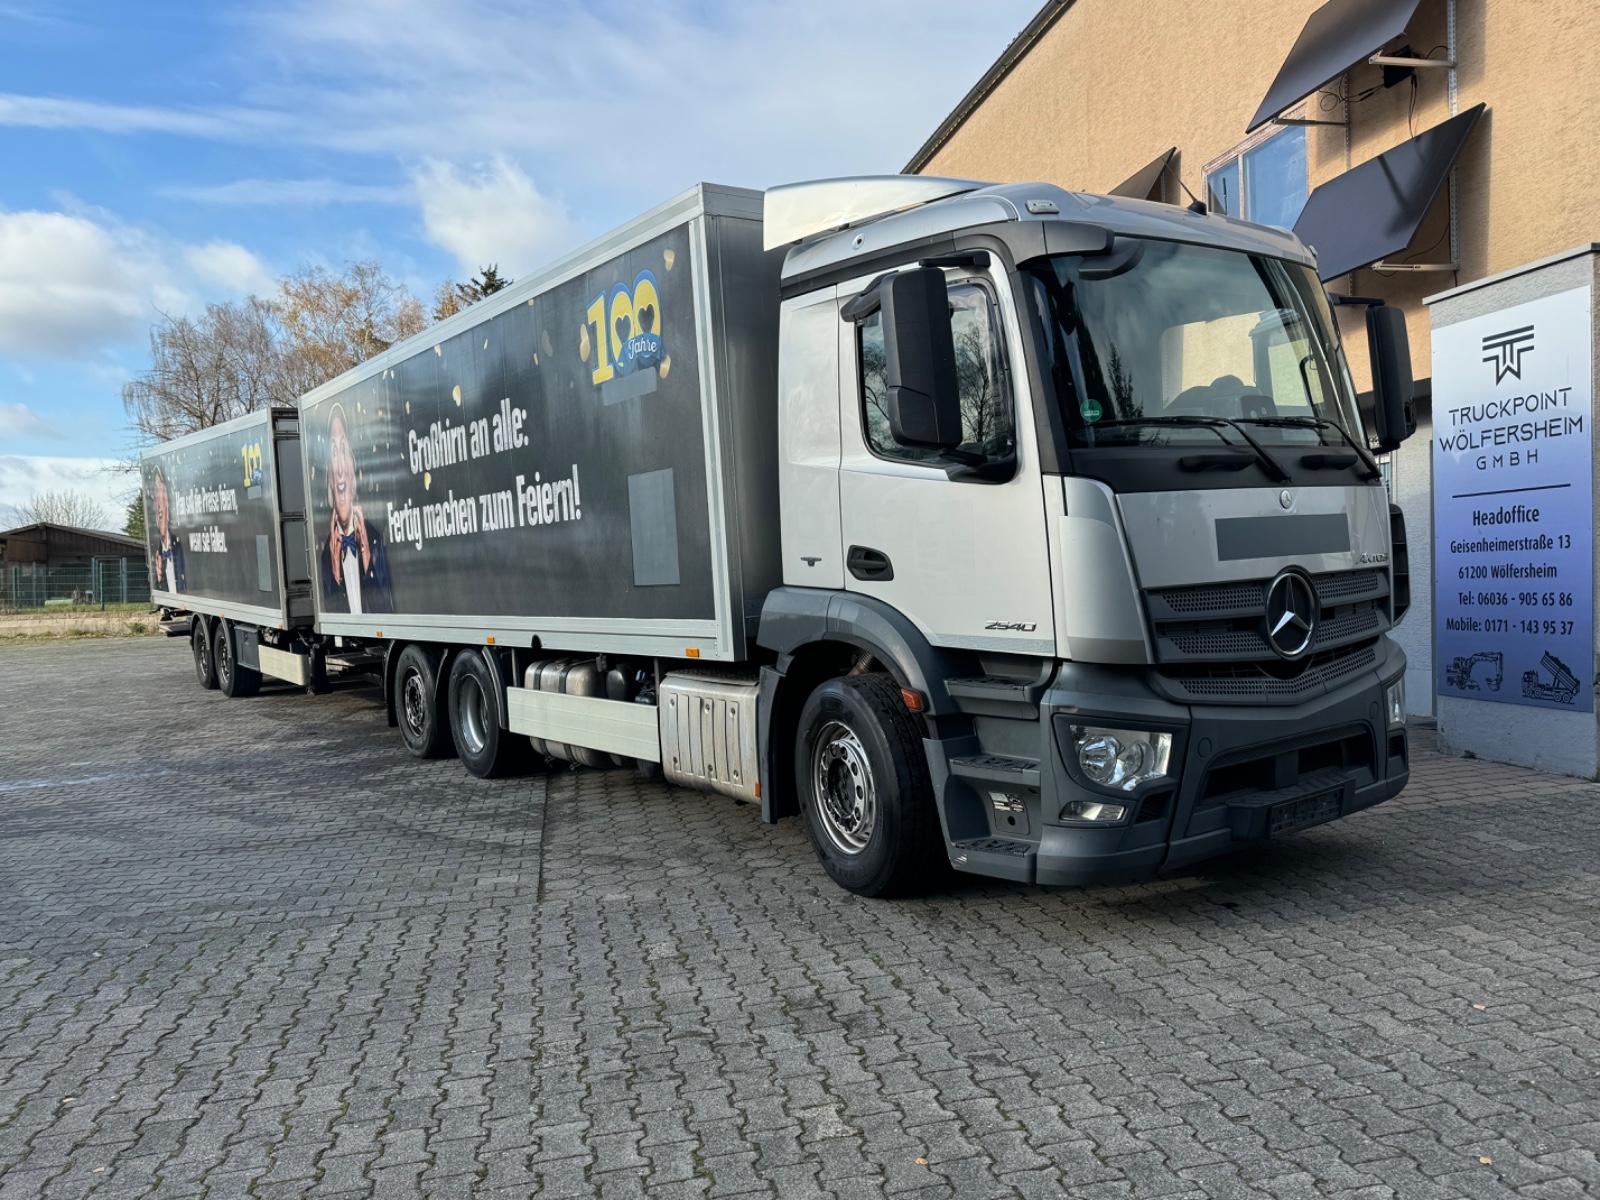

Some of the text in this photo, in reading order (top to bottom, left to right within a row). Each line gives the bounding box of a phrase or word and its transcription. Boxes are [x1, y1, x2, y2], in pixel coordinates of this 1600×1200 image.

[1448, 387, 1572, 426] TRUCKPOINT
[408, 397, 529, 475] Großhirn an alle:
[1439, 415, 1583, 452] WÖLFERSHEIM
[1476, 449, 1538, 470] GMBH
[387, 463, 582, 551] Fertig machen zum Feiern!
[1472, 505, 1540, 526] Headoffice
[1450, 534, 1571, 554] Geisenheimerstraße 13
[1458, 562, 1558, 579] 61200 Wölfersheim
[1458, 591, 1475, 606] Tel:
[1477, 592, 1508, 606] 06036
[1519, 592, 1538, 606] 905
[1542, 592, 1555, 606] 65
[1559, 592, 1573, 607] 86
[984, 620, 1037, 632] 2540
[1446, 616, 1482, 632] Mobile:
[1484, 619, 1508, 633] 0171
[1521, 620, 1540, 634] 143
[1543, 620, 1556, 635] 95
[1560, 620, 1574, 635] 37
